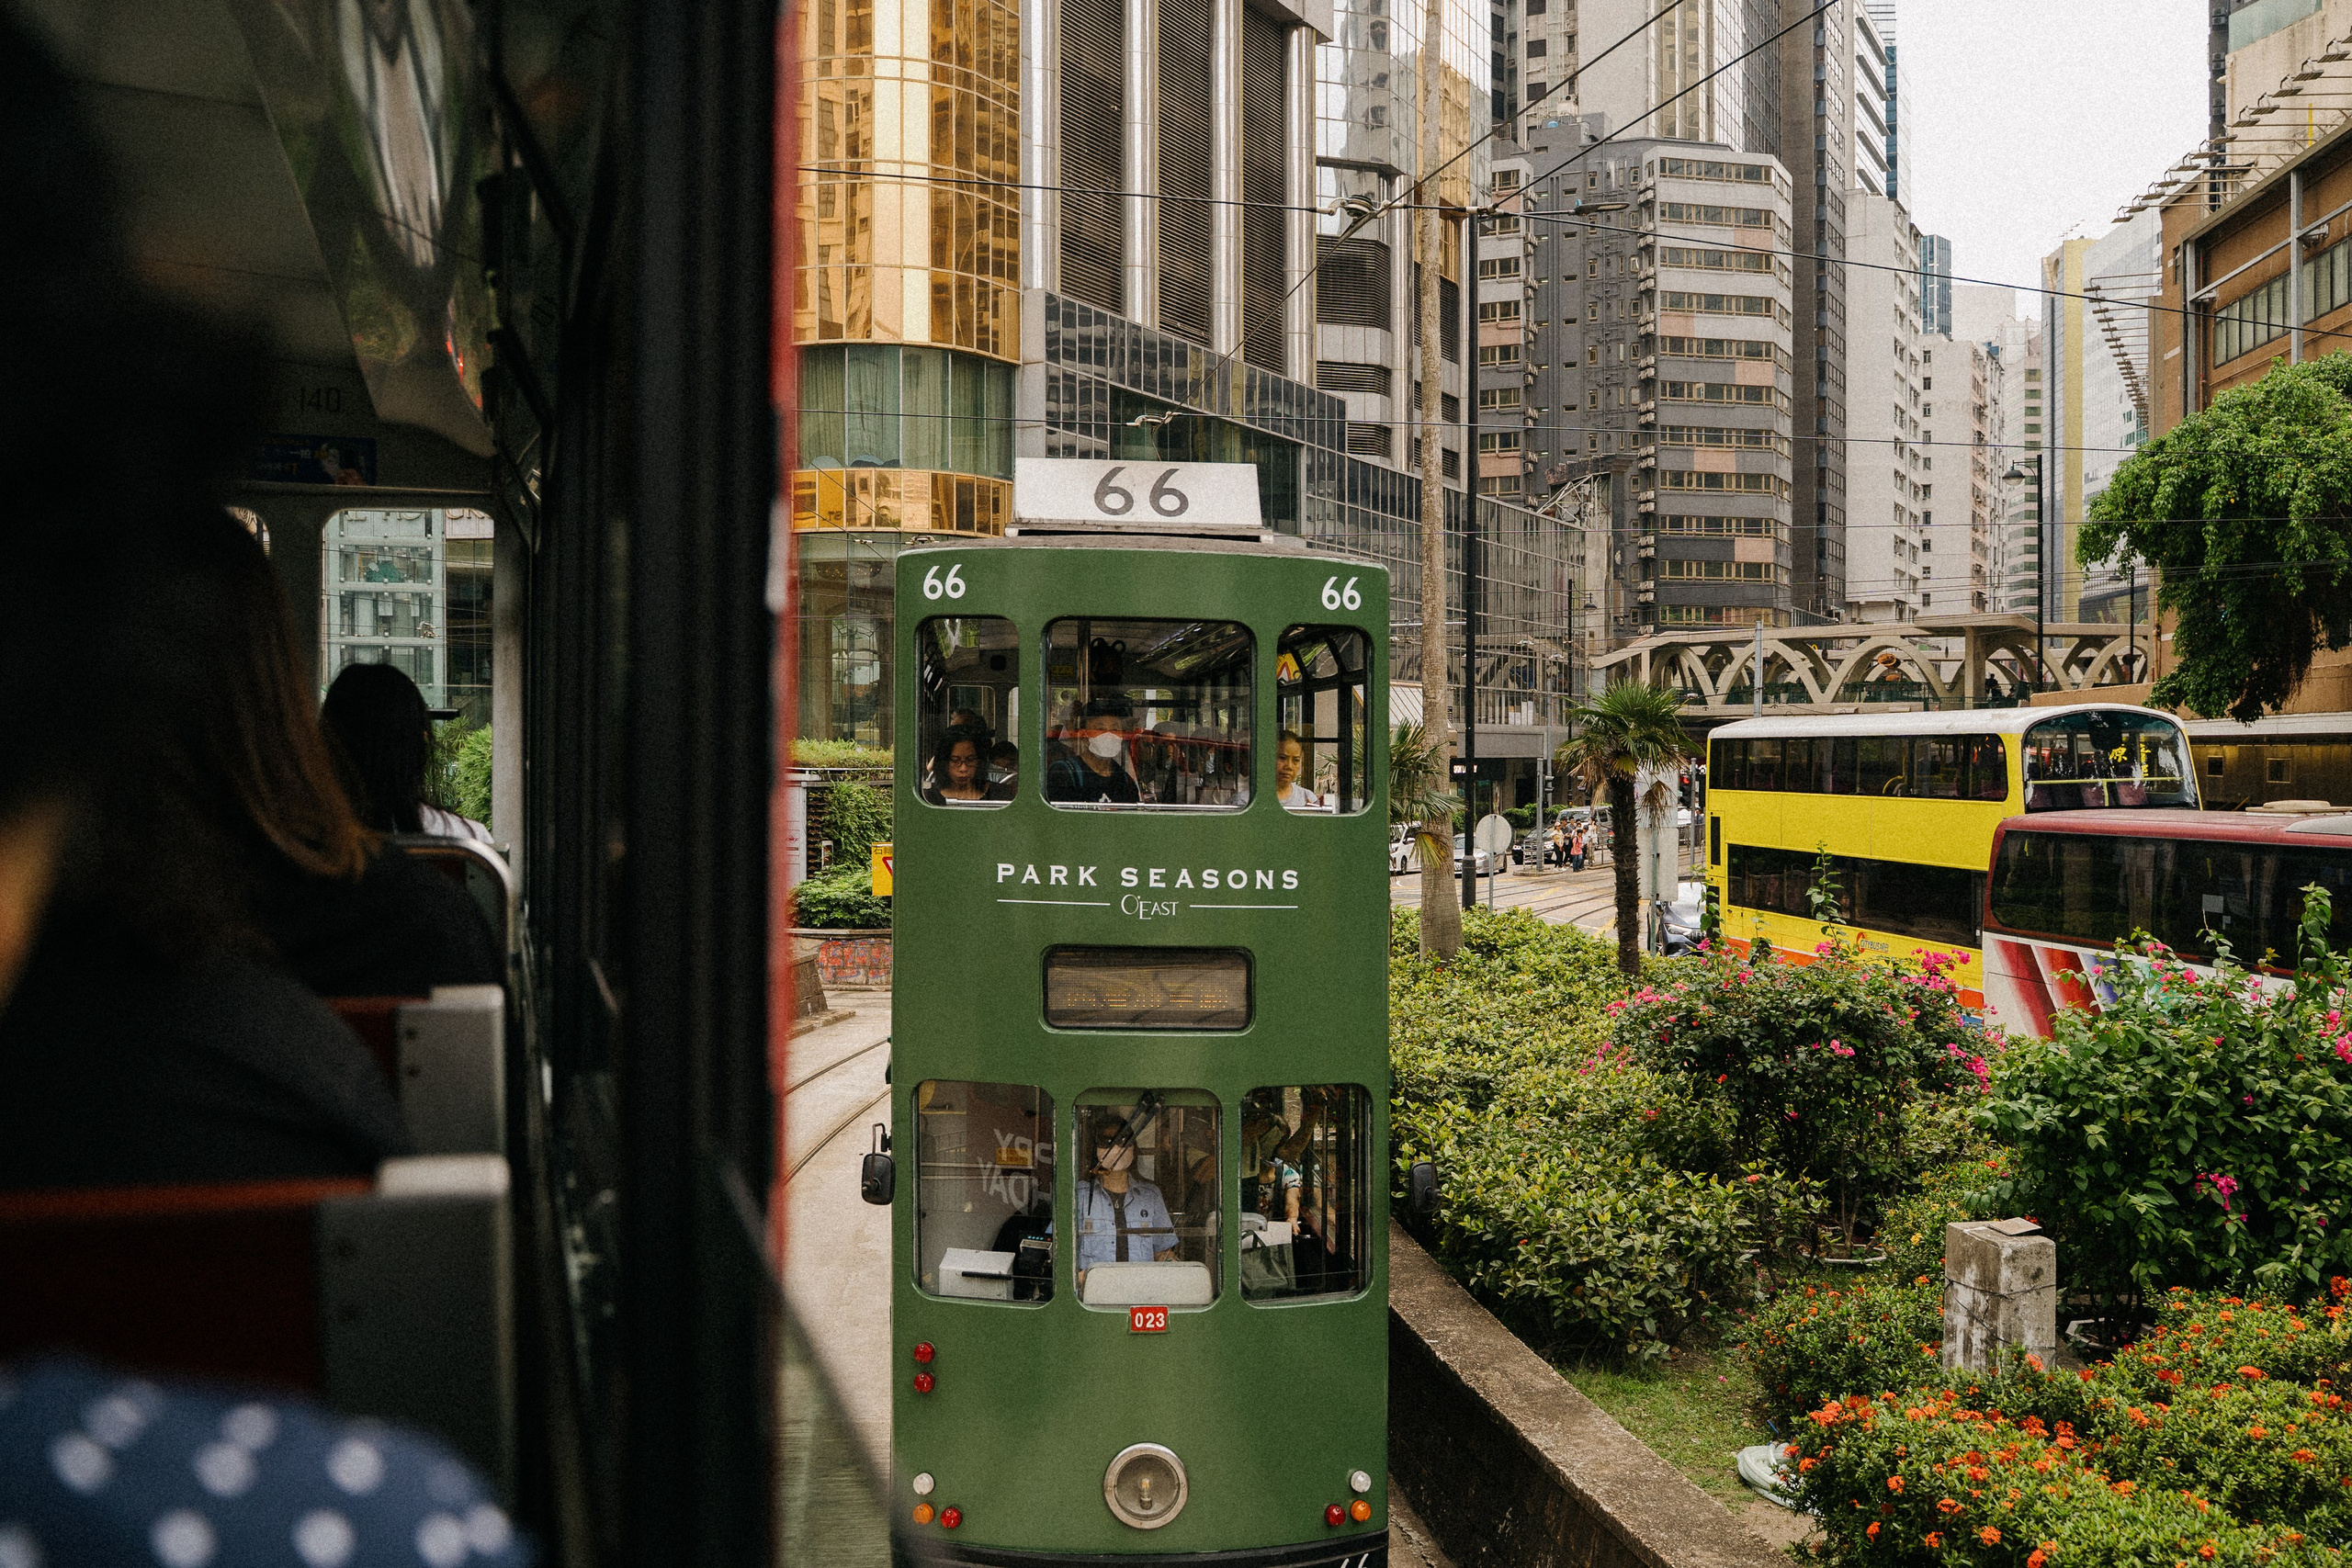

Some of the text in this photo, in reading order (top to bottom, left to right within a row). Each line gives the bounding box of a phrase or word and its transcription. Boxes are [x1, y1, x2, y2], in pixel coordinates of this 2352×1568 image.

[1093, 466, 1190, 517] 66
[922, 564, 967, 601] 66
[1321, 576, 1362, 611] 66
[996, 863, 1299, 889] PARK SEASONS
[1135, 1312, 1165, 1328] 023
